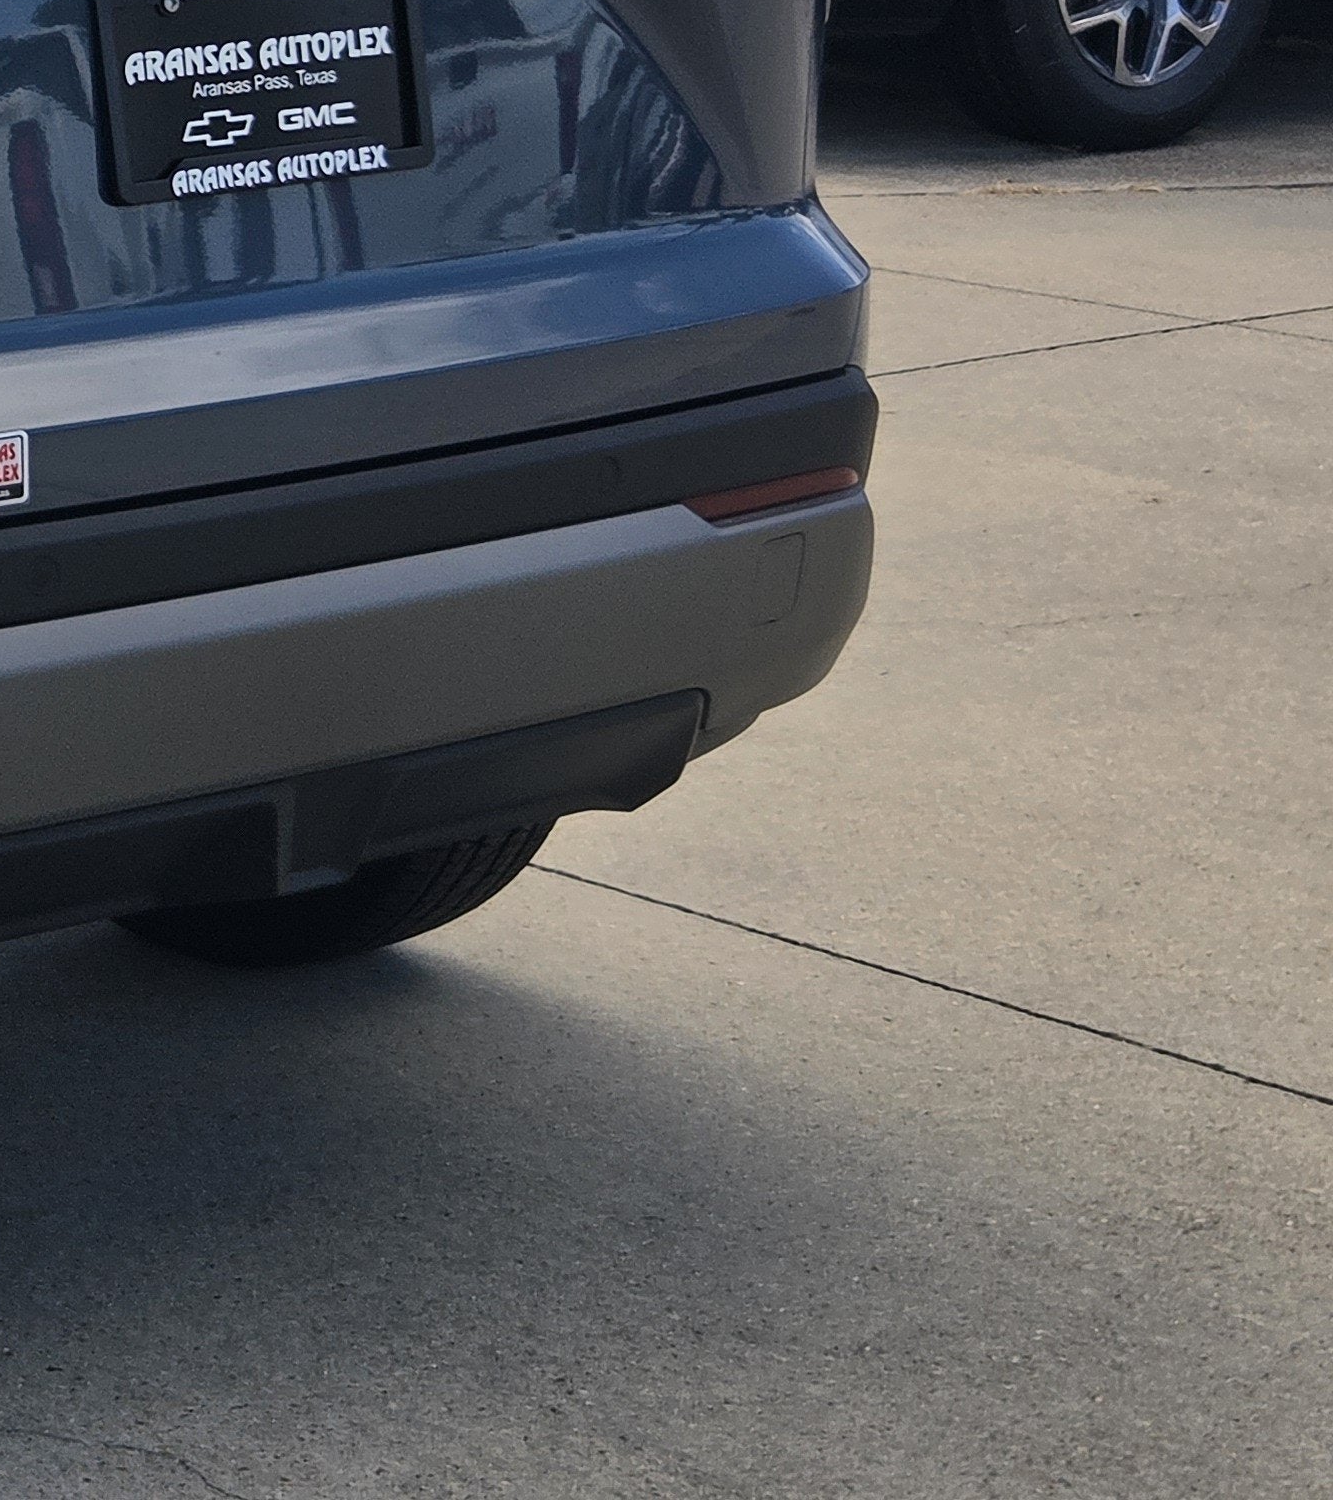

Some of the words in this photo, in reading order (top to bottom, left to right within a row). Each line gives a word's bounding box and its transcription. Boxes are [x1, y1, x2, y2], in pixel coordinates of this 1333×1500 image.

[124, 40, 254, 86] ARANSAS
[259, 25, 395, 70] AUTOPLEX
[192, 79, 253, 99] Aransas
[253, 74, 294, 91] Pass,
[295, 69, 338, 86] Texas
[278, 101, 358, 132] GMC
[171, 158, 273, 197] ARANSAS
[277, 144, 389, 182] AUTOPLEX
